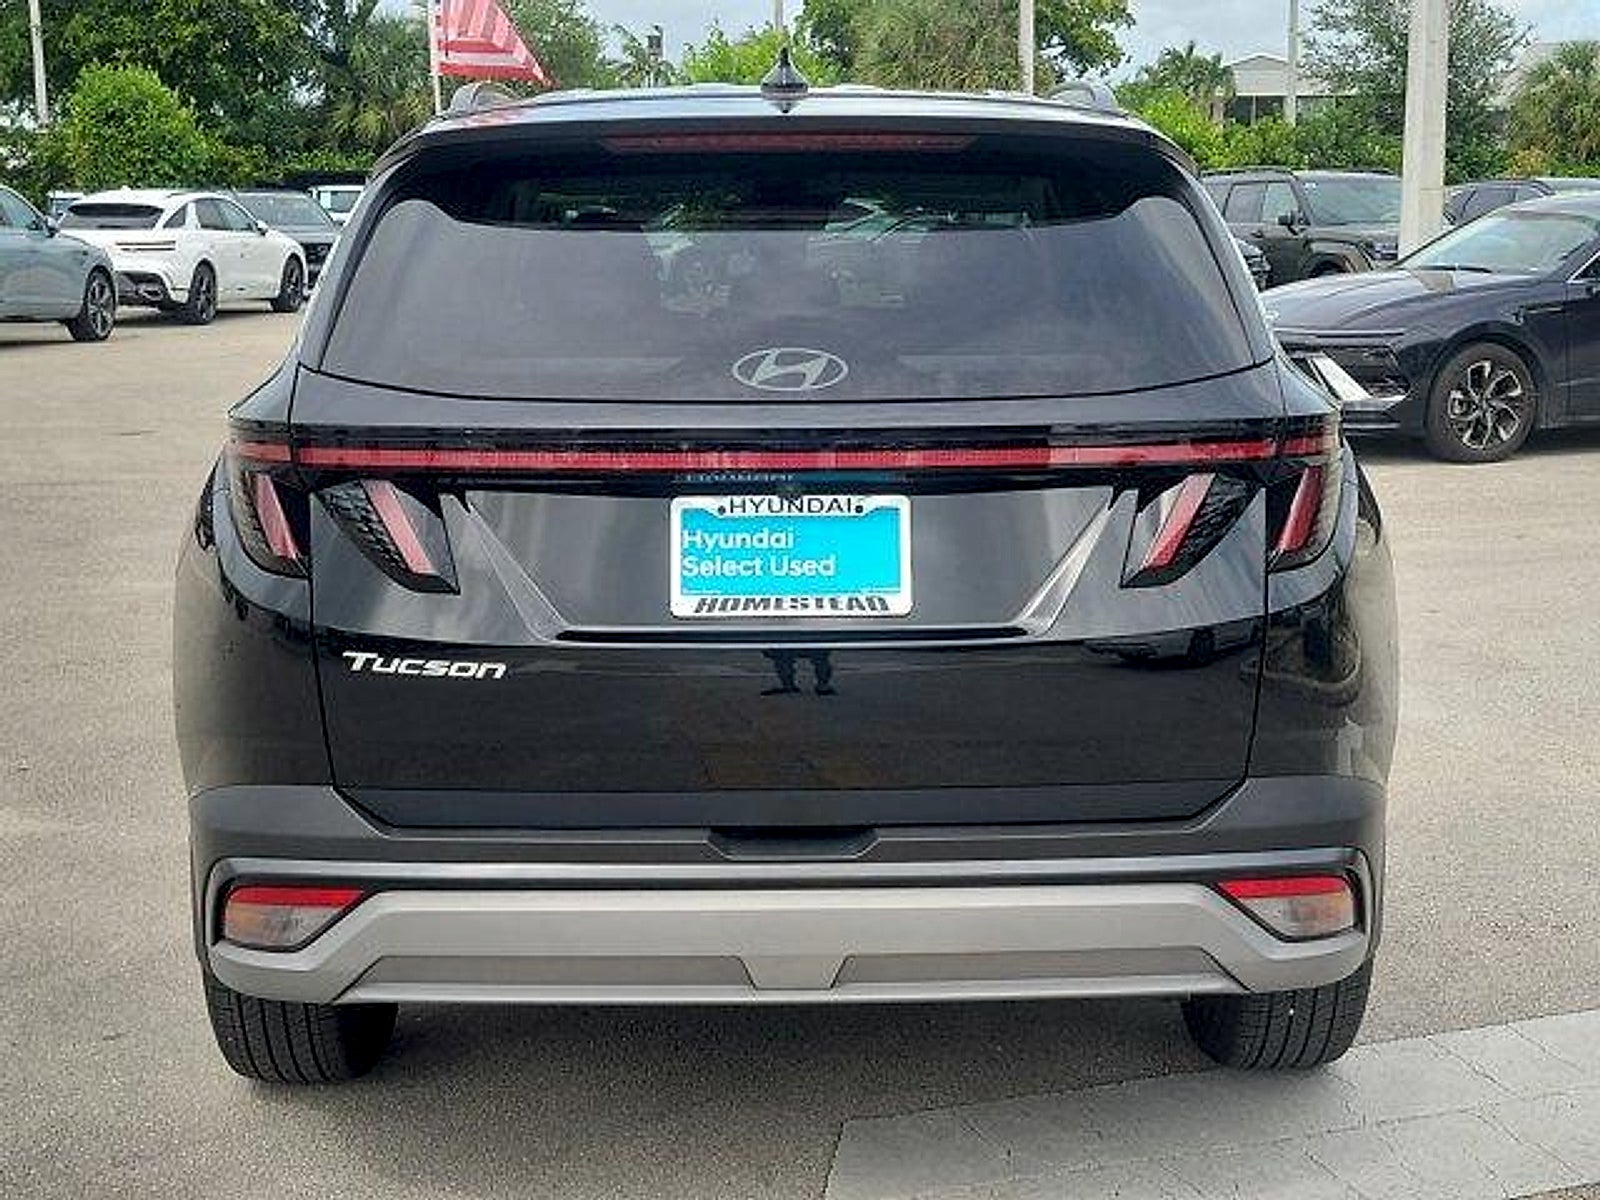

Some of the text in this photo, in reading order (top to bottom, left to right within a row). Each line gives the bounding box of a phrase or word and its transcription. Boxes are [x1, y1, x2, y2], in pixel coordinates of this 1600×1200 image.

[730, 497, 851, 513] HYUNDAI
[682, 528, 794, 553] Hyundai
[682, 554, 836, 577] Select Used
[343, 651, 507, 679] Tucson
